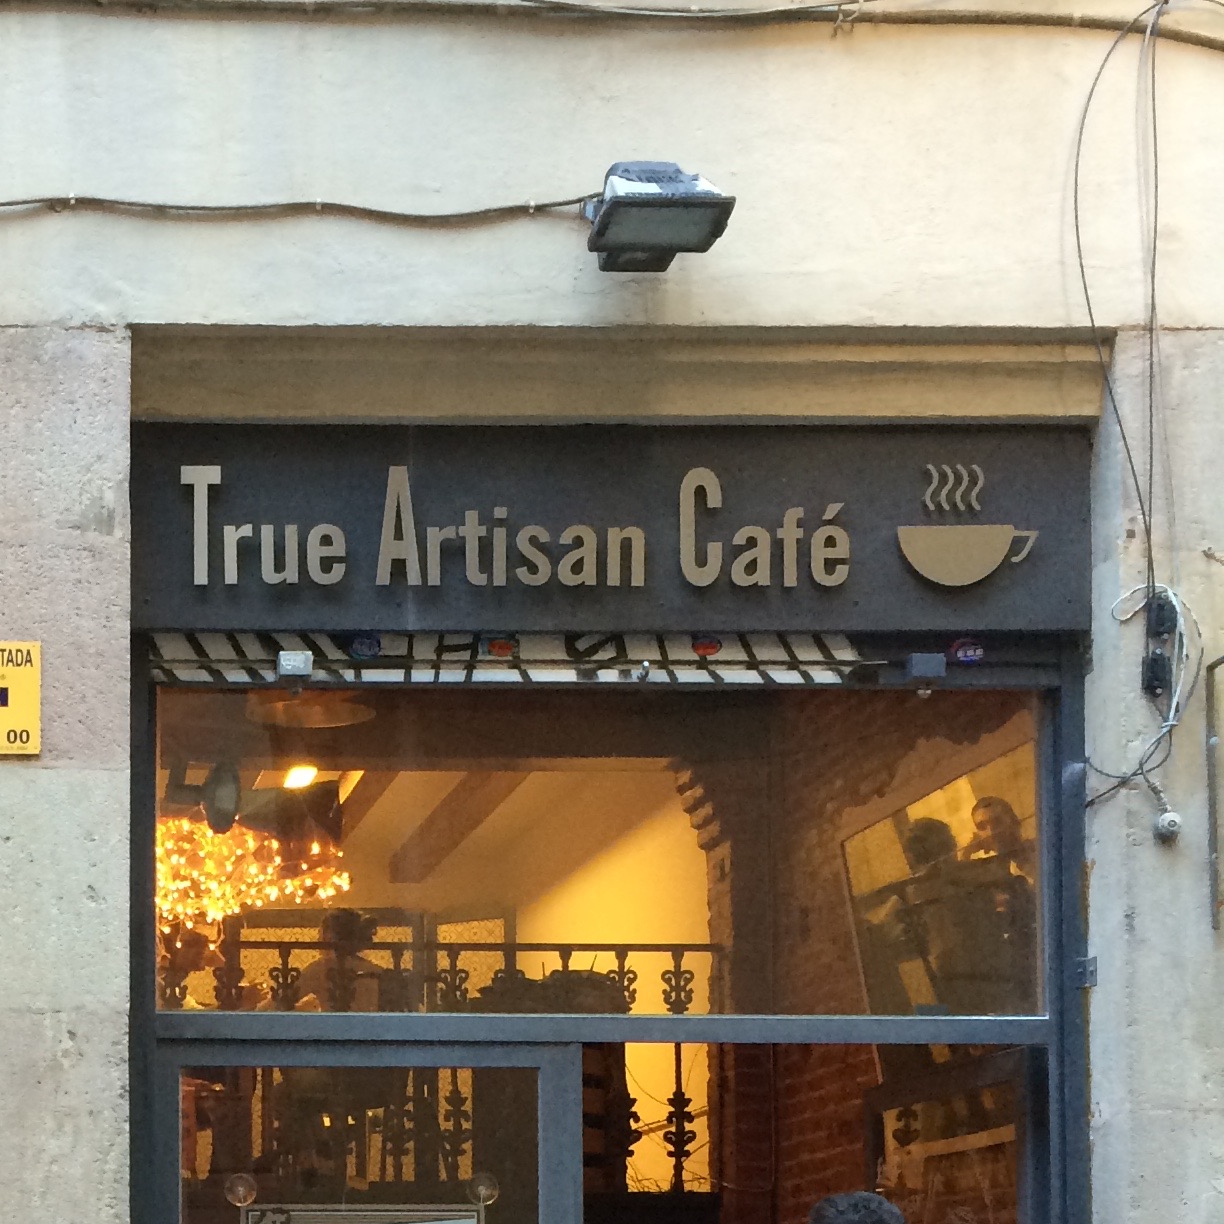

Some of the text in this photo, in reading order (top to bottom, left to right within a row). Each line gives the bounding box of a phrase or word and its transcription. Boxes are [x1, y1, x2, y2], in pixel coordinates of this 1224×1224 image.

[180, 465, 852, 588] True Artisan Café
[6, 729, 31, 744] 00
